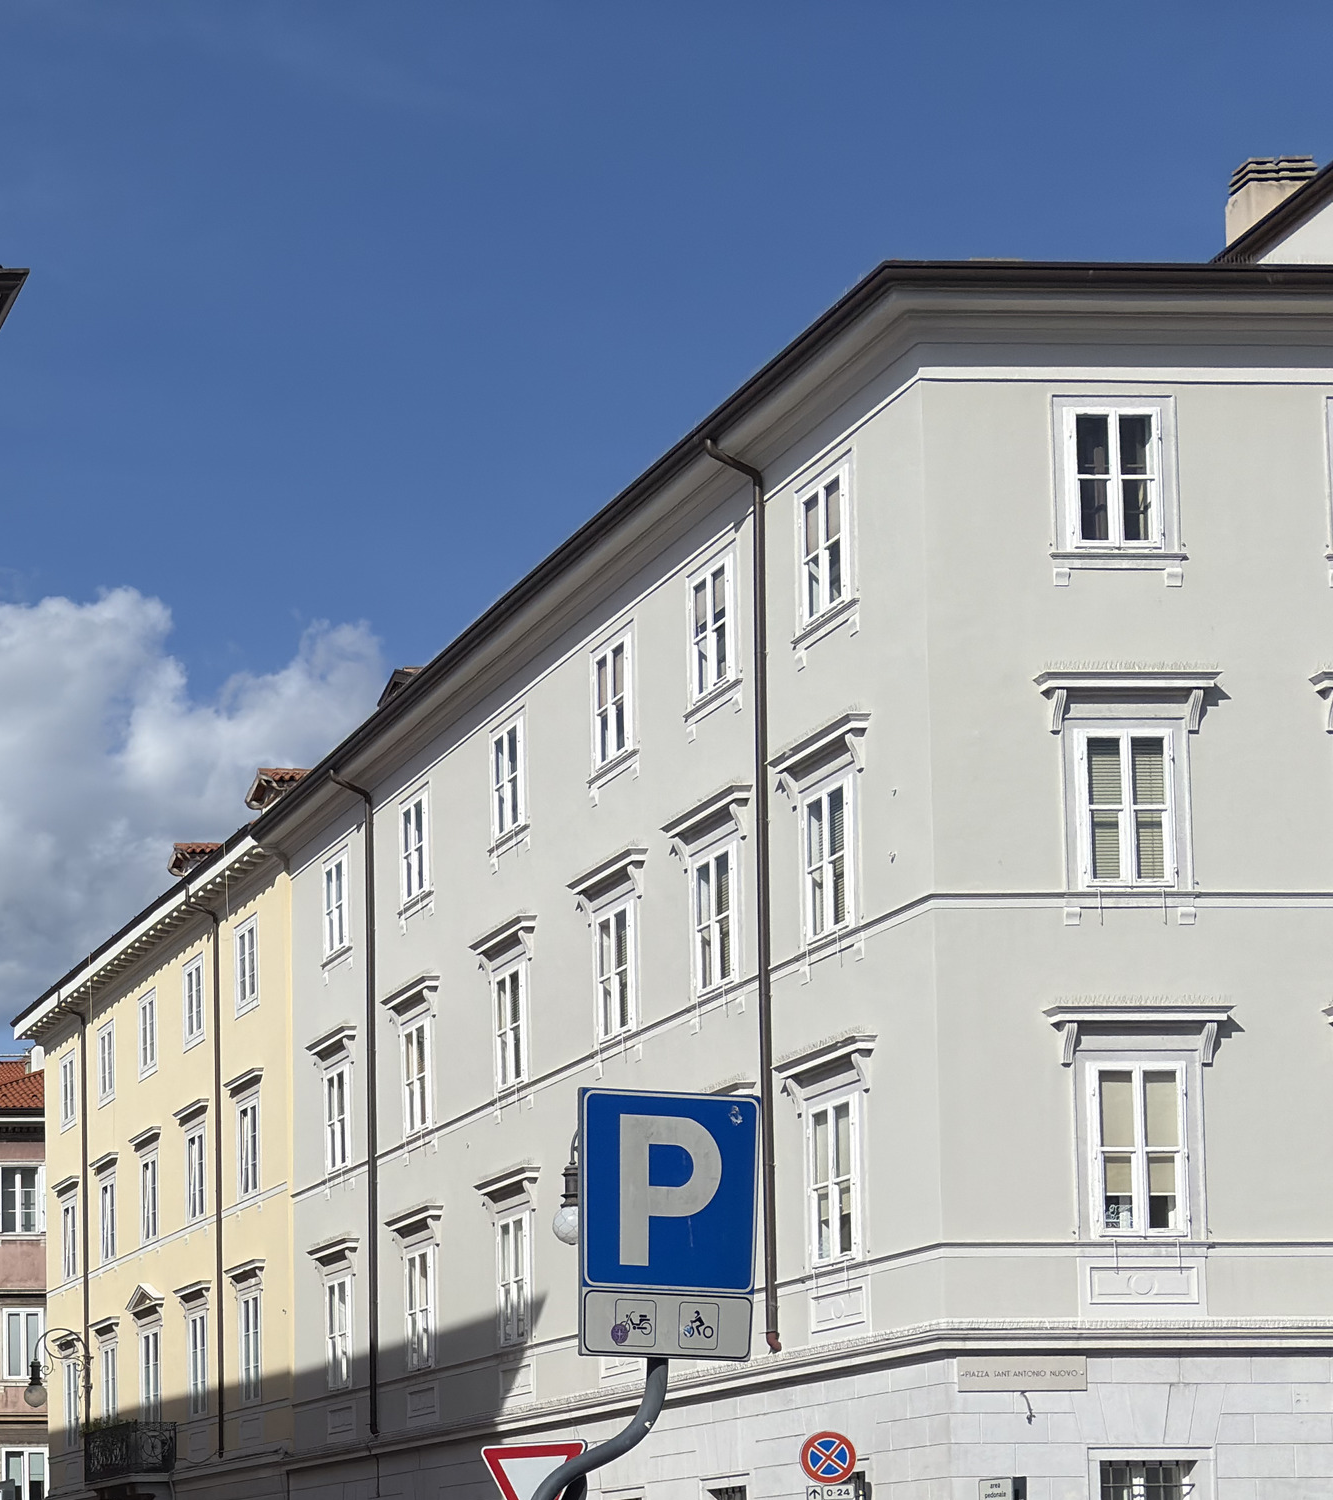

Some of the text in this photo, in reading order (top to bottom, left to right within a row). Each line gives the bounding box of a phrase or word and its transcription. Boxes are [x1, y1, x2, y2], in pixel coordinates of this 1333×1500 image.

[619, 1113, 722, 1266] P
[1049, 1369, 1078, 1377] NUOVO
[984, 1490, 1007, 1499] pedonale
